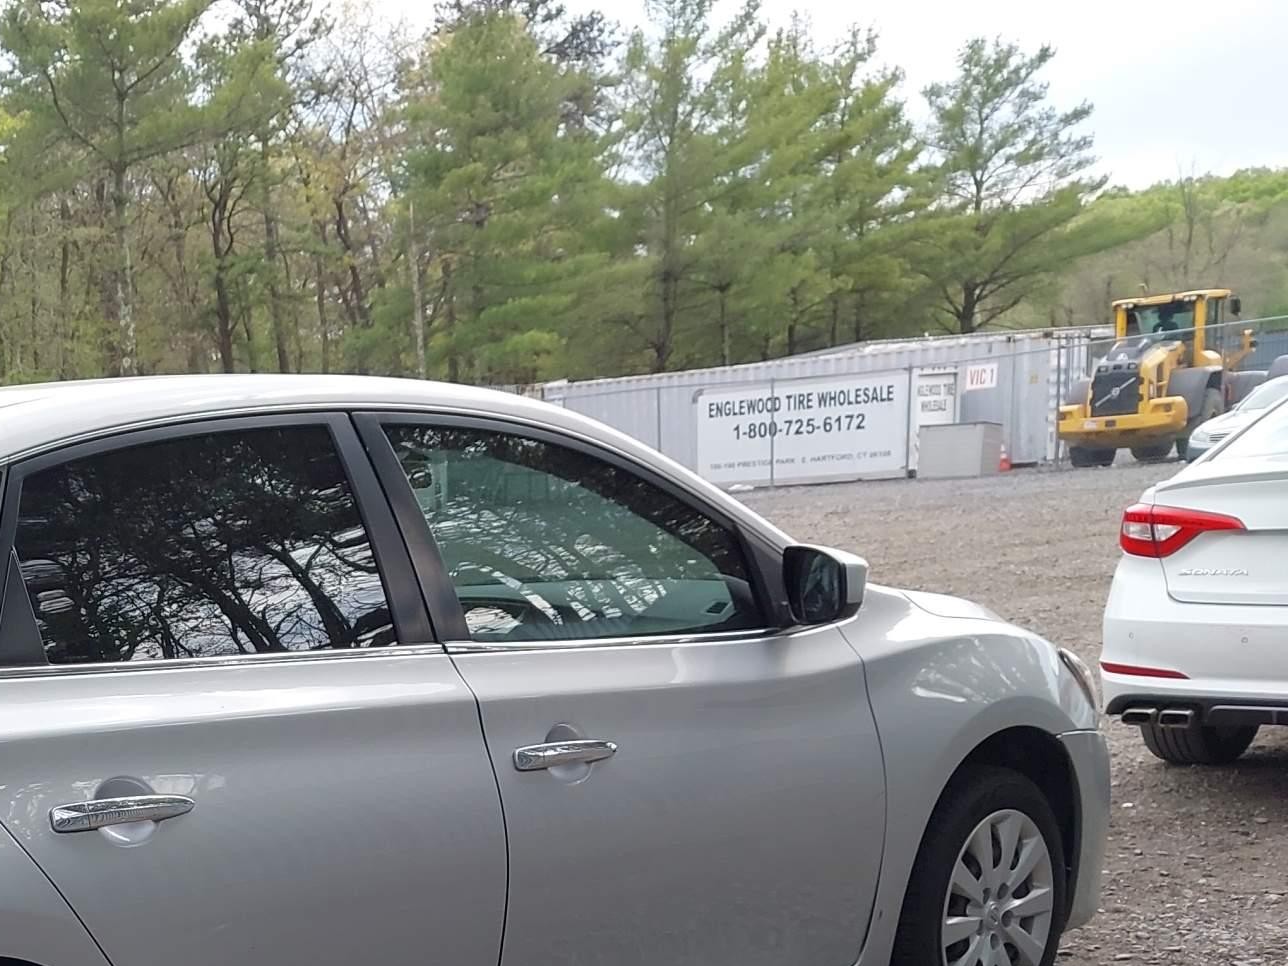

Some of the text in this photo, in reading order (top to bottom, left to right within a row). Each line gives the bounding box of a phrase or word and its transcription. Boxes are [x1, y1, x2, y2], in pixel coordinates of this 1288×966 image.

[969, 367, 987, 385] VIC
[708, 385, 895, 418] ENGLEWOOD TIRE WHOLESALE
[733, 413, 866, 440] 1-800-725-6172
[1178, 567, 1249, 577] SONATA
